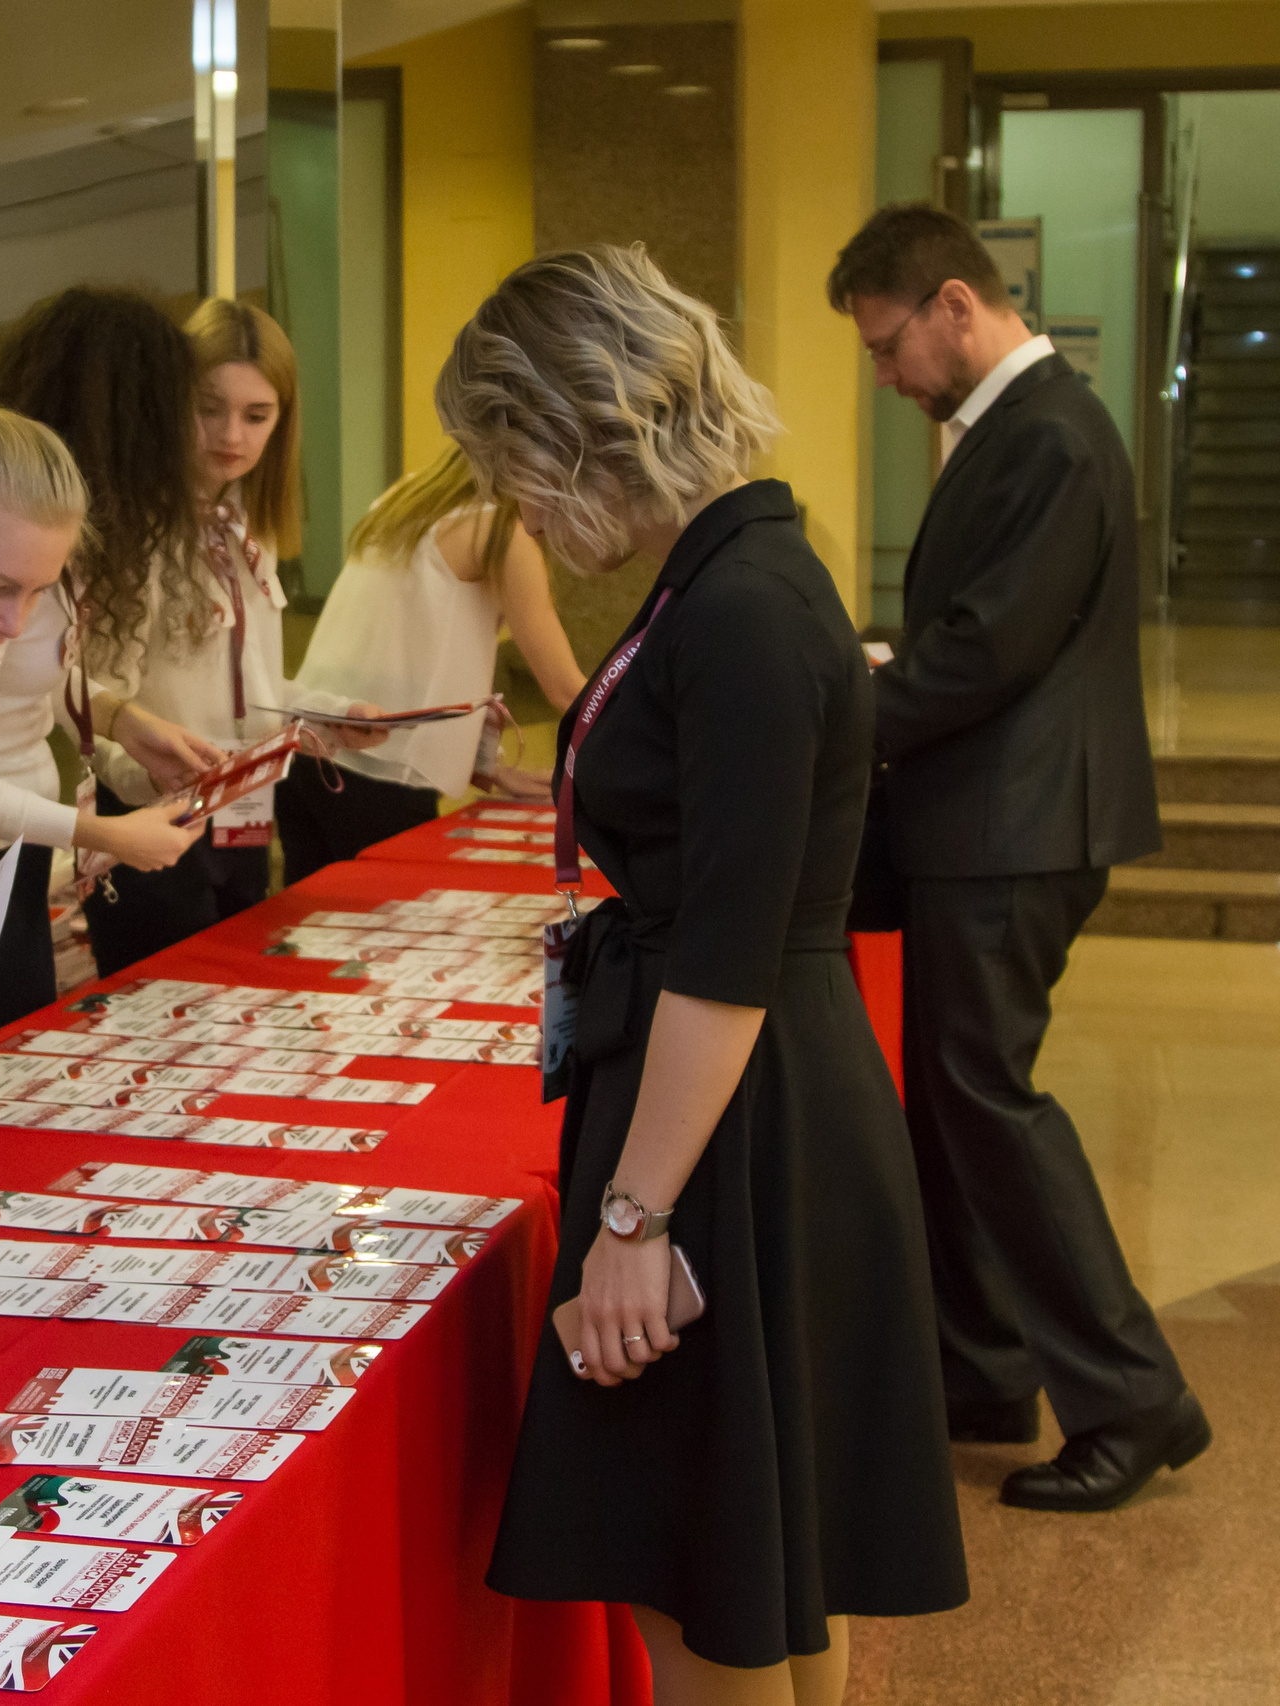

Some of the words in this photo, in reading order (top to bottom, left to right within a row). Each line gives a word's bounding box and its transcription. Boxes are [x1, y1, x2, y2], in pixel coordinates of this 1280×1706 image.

[121, 1421, 156, 1462] БЕЗОПАСНОСТЬ
[218, 1434, 270, 1475] БЕЗОПАСНОСТЬ
[75, 1552, 139, 1605] БЕЗОПАСНОСТЬ
[79, 1551, 119, 1581] БИЗНЕСА
[95, 1583, 126, 1606] ФОРУМ
